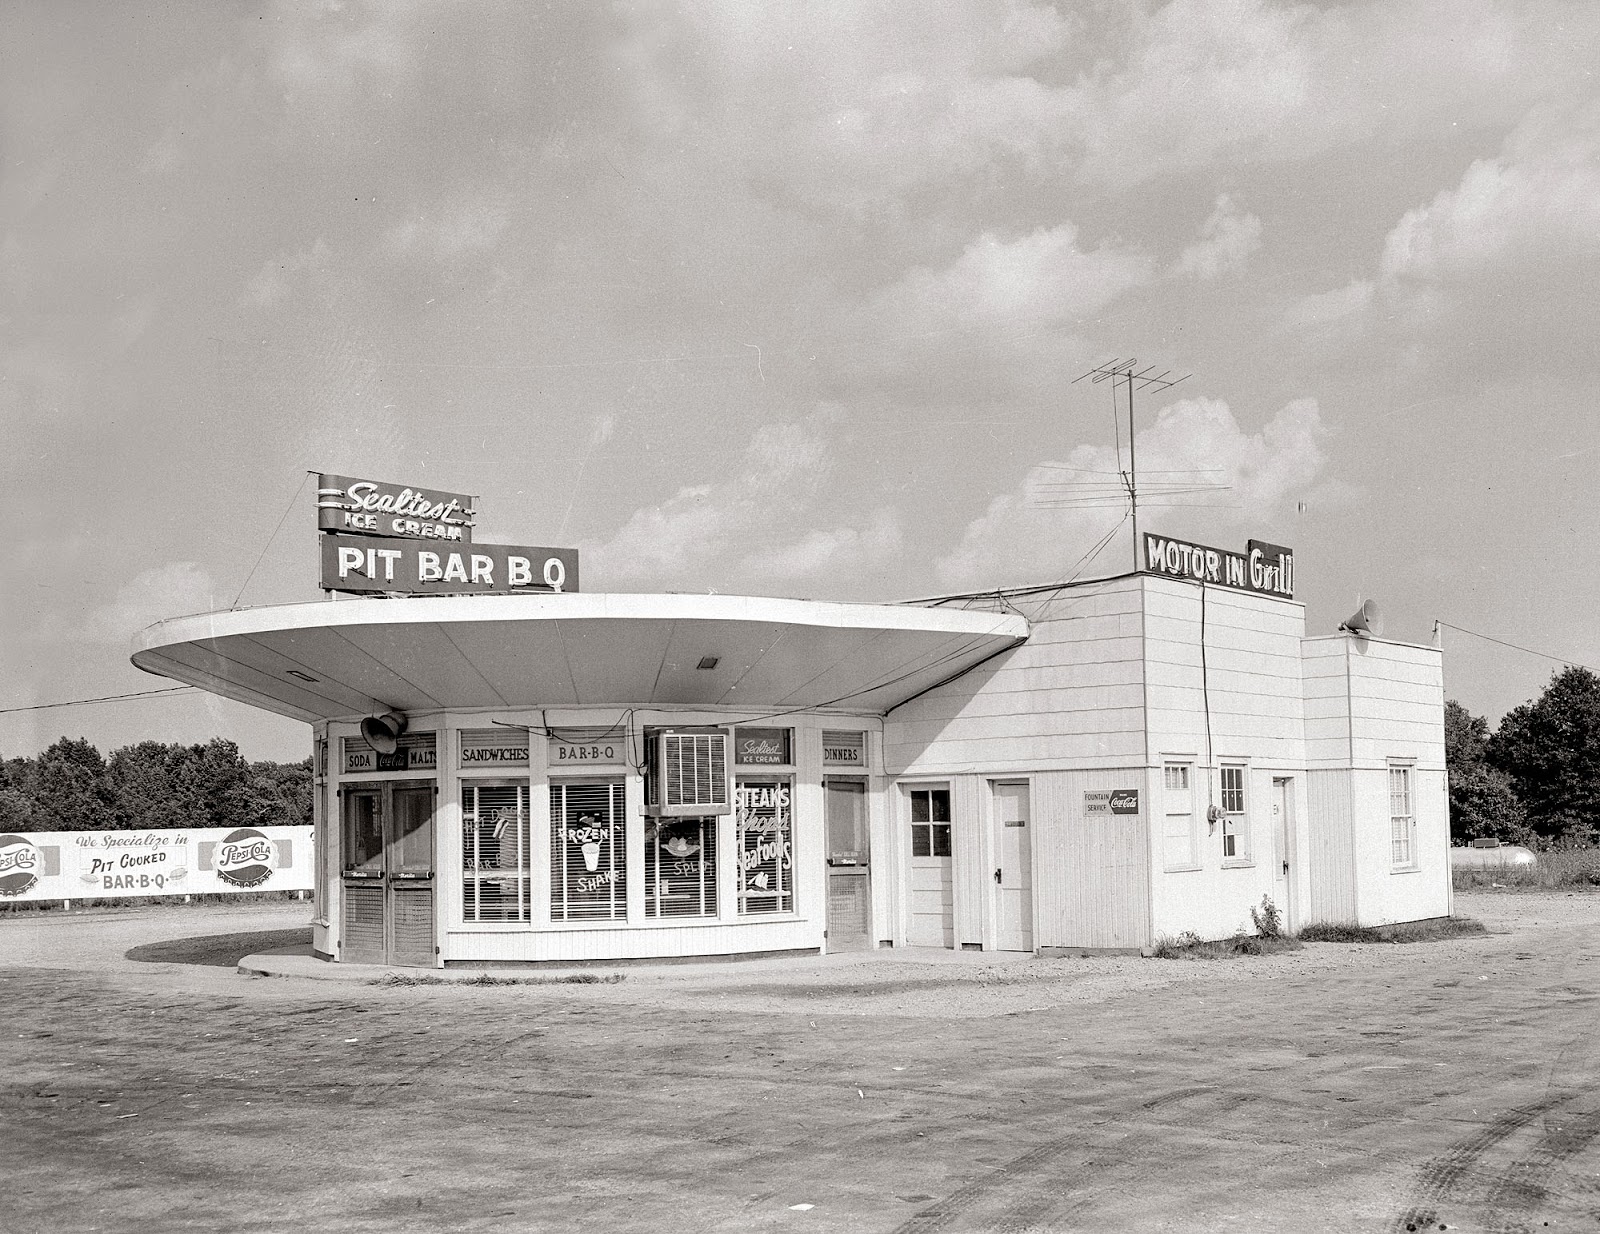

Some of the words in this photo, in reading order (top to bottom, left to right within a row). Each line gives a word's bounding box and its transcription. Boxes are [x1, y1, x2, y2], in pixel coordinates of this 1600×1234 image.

[341, 482, 463, 525] Sealtest
[345, 511, 377, 530] ICE
[392, 518, 462, 541] CREAM
[338, 546, 401, 580] PIT
[418, 552, 494, 587] BAR
[508, 556, 532, 587] B
[543, 558, 565, 592] Q
[1148, 537, 1222, 583] MOTOR
[1225, 554, 1248, 587] IN
[1250, 548, 1294, 595] Grill
[462, 748, 529, 761] SANDWICHES
[559, 746, 614, 759] BAR-B-Q
[741, 740, 782, 754] Sealtest
[824, 748, 858, 760] DINNERS
[349, 754, 371, 767] SODA
[743, 755, 754, 763] ICE
[756, 755, 780, 763] CREAM
[735, 787, 790, 808] STEAKS
[1084, 793, 1110, 801] FOUNTAIN
[737, 808, 790, 836] Chops
[76, 835, 98, 848] We
[101, 833, 170, 851] Specialize
[175, 833, 189, 845] in
[558, 827, 609, 844] FROZEN
[91, 858, 114, 874] PIT
[120, 852, 167, 868] COOKED
[577, 870, 620, 892] SHAKE
